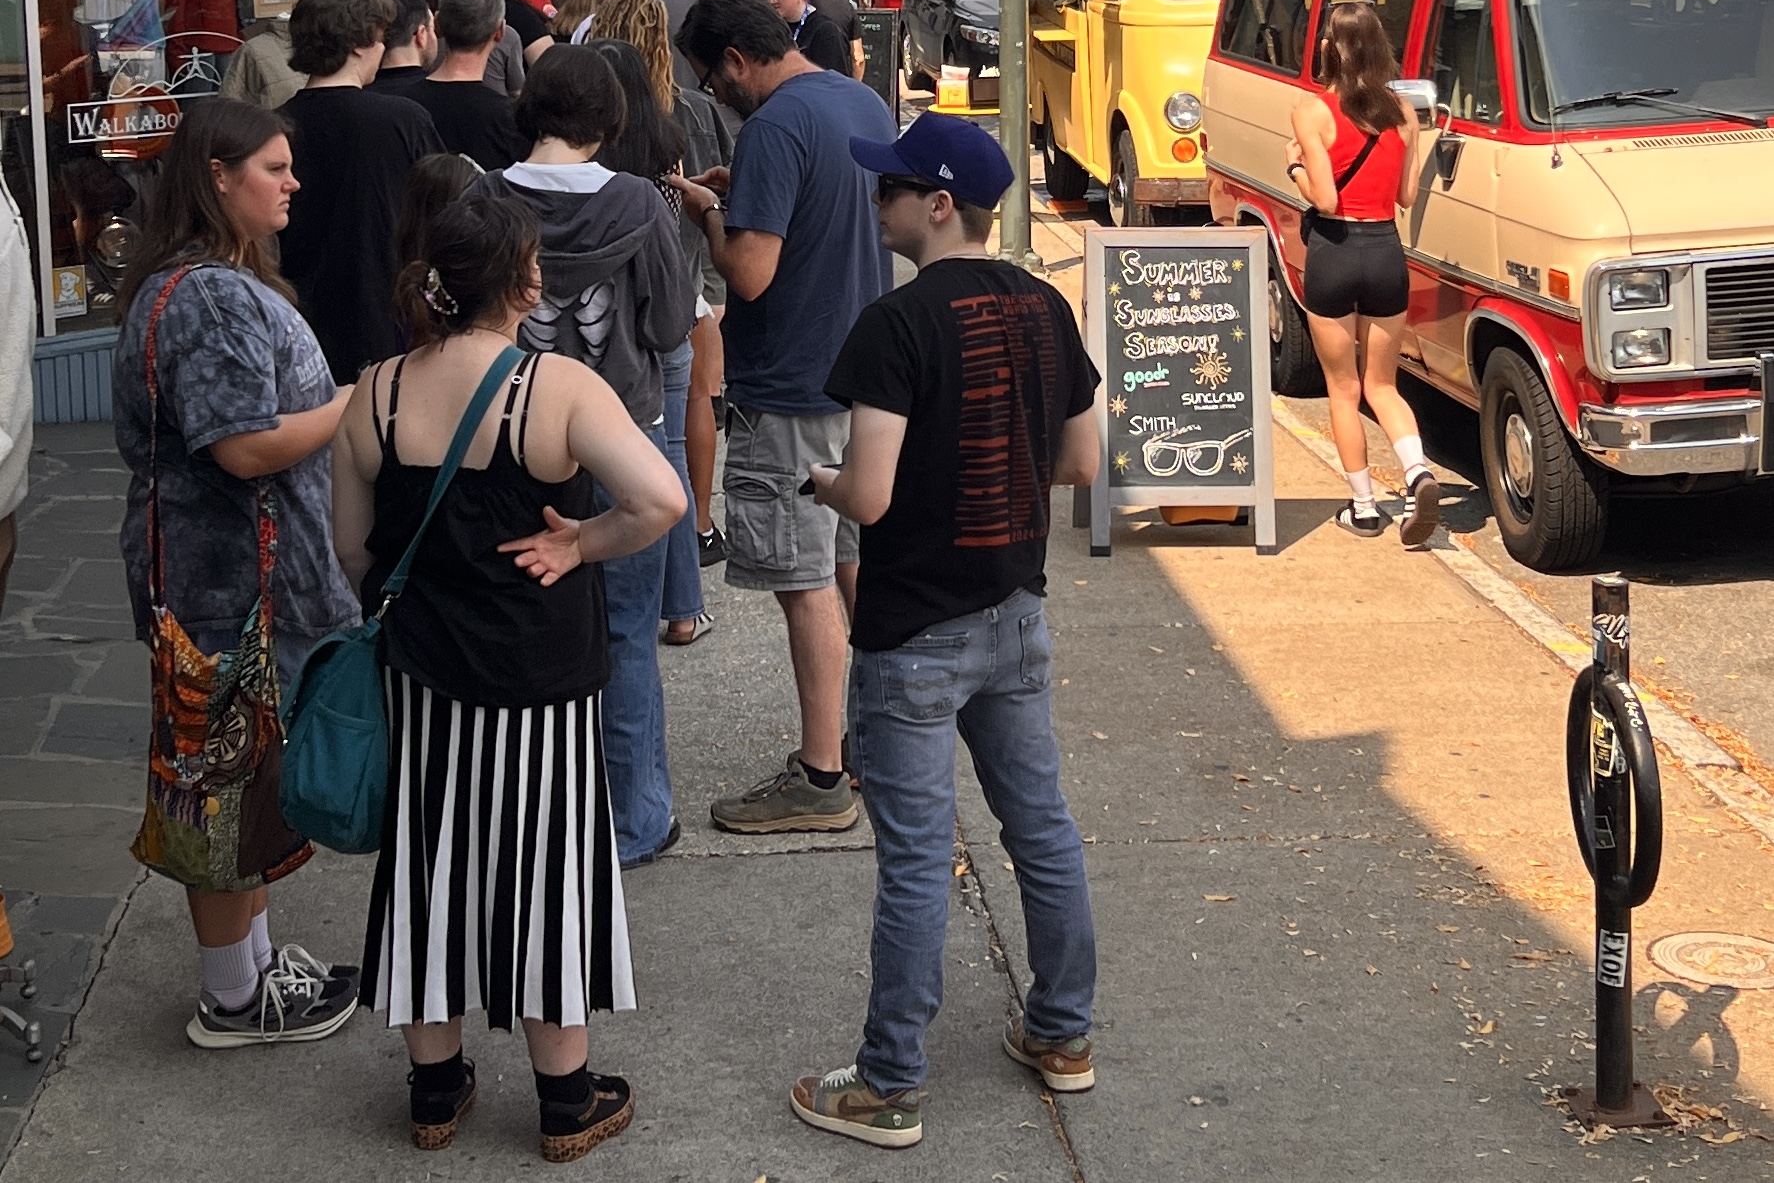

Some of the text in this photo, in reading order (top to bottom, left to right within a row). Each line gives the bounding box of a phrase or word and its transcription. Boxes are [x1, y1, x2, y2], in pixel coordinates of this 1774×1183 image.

[72, 107, 184, 137] WALKABO
[1120, 250, 1230, 285] SUMMER
[1113, 299, 1239, 330] SUNGLASSES
[1123, 362, 1170, 393] goodr
[1128, 415, 1177, 436] SMITH
